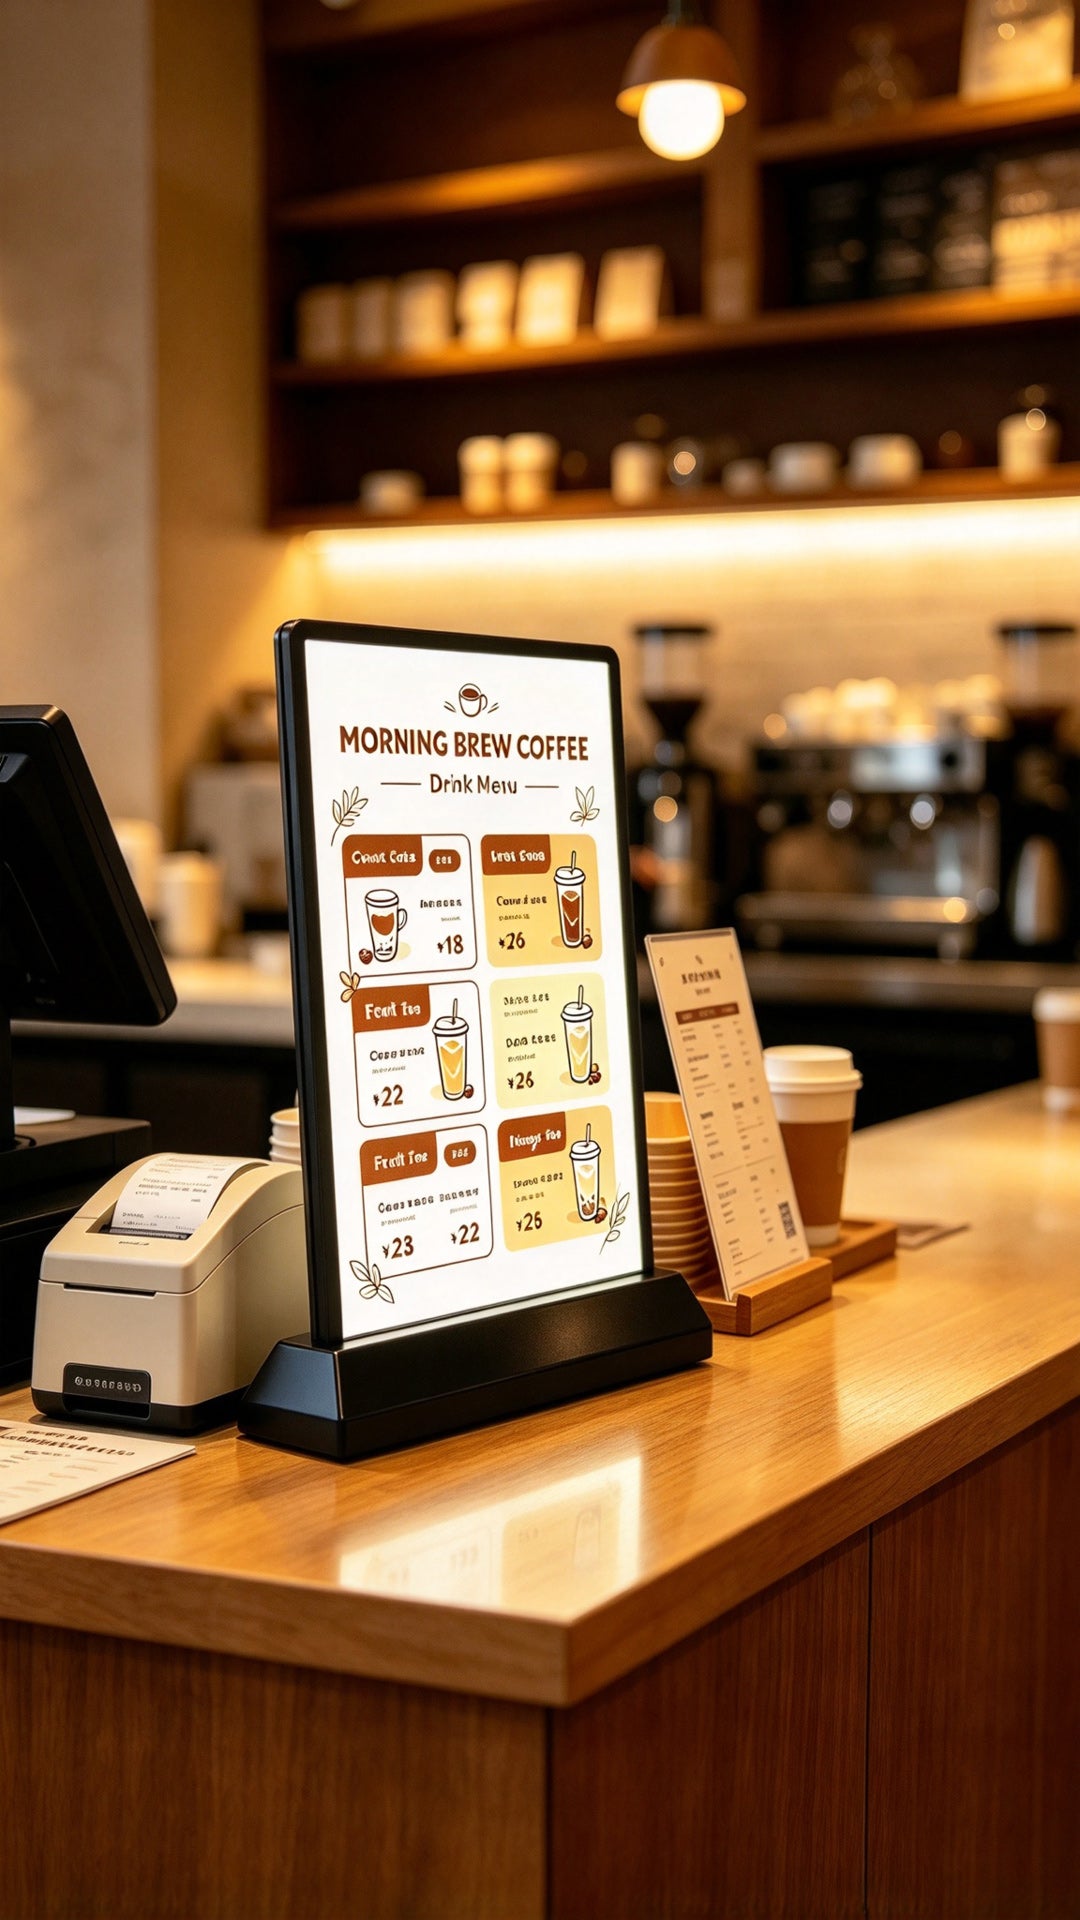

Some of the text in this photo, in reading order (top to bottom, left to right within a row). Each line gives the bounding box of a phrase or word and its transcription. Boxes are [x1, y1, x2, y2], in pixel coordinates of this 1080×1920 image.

[339, 725, 589, 761] MORNING BREW COFFEE
[430, 773, 474, 794] Drink
